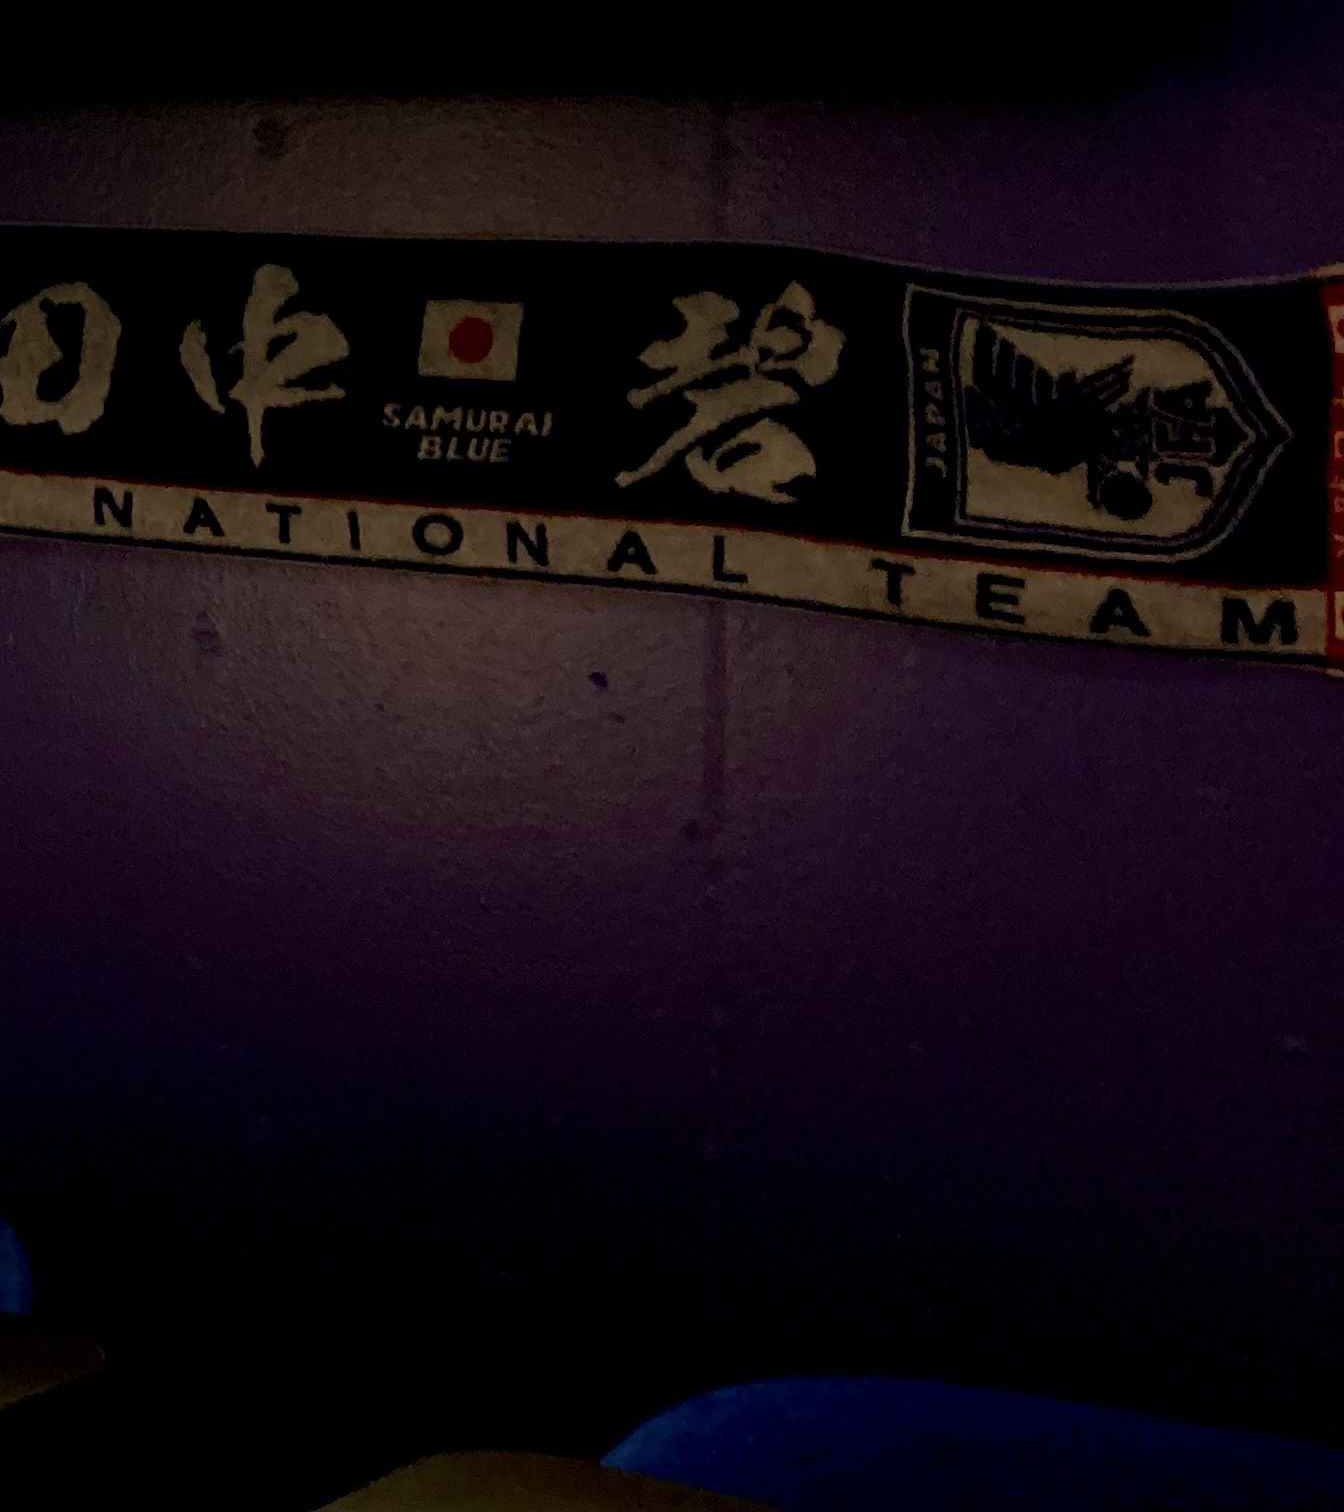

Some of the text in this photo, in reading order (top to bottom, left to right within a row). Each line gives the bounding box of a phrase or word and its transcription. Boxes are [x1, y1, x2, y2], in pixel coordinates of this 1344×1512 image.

[382, 402, 555, 439] SAMURAI
[416, 435, 513, 465] BLUE
[919, 345, 950, 479] JAPAN
[92, 487, 749, 585] NATIONAL
[869, 558, 1299, 645] TEAM
